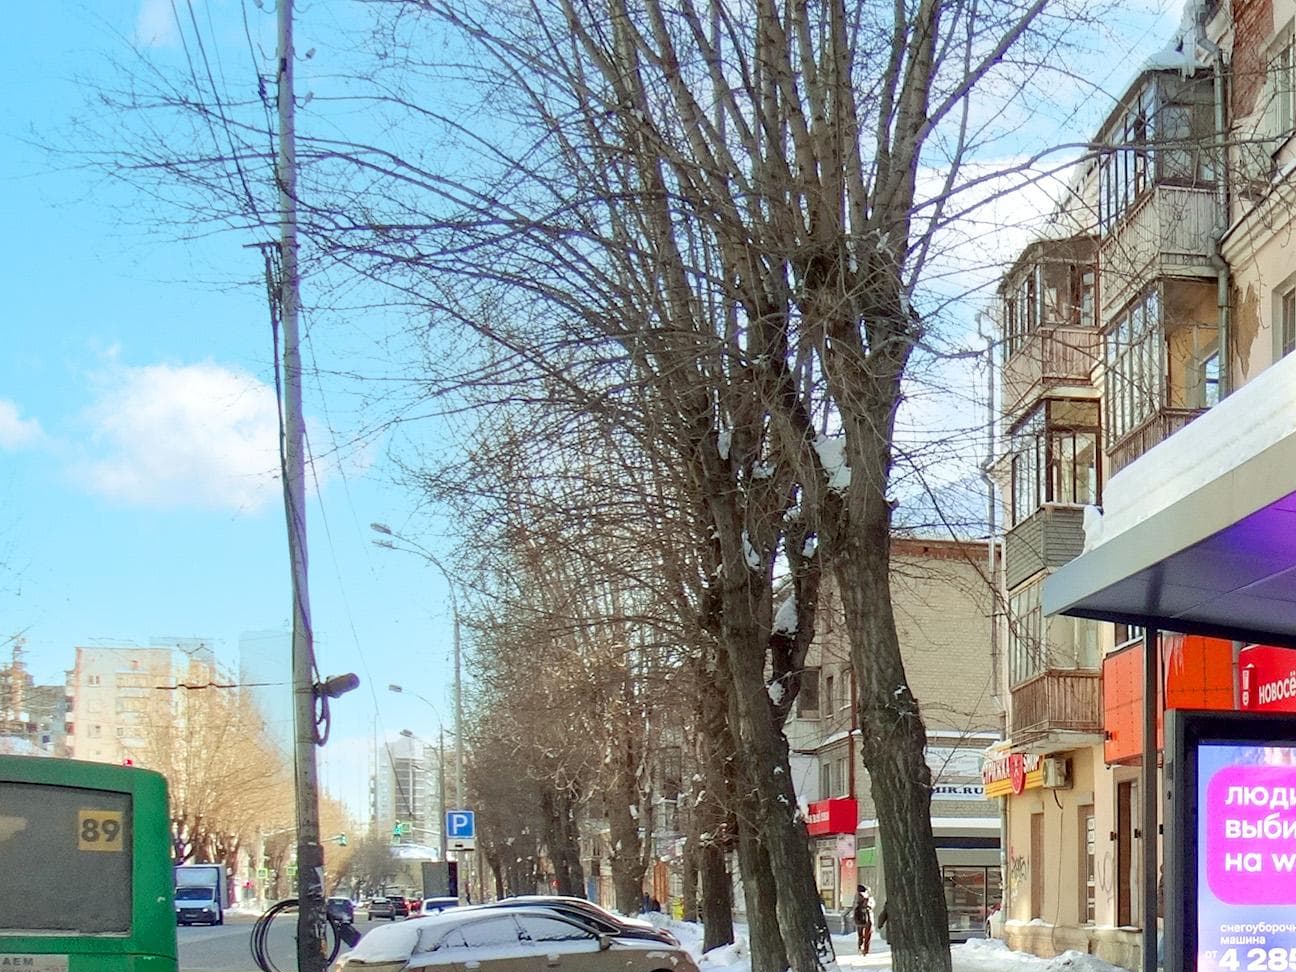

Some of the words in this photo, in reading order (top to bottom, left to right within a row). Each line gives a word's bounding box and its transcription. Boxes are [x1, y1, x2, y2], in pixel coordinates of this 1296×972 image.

[81, 818, 120, 842] 89
[1225, 853, 1262, 872] на
[1220, 936, 1266, 945] машина
